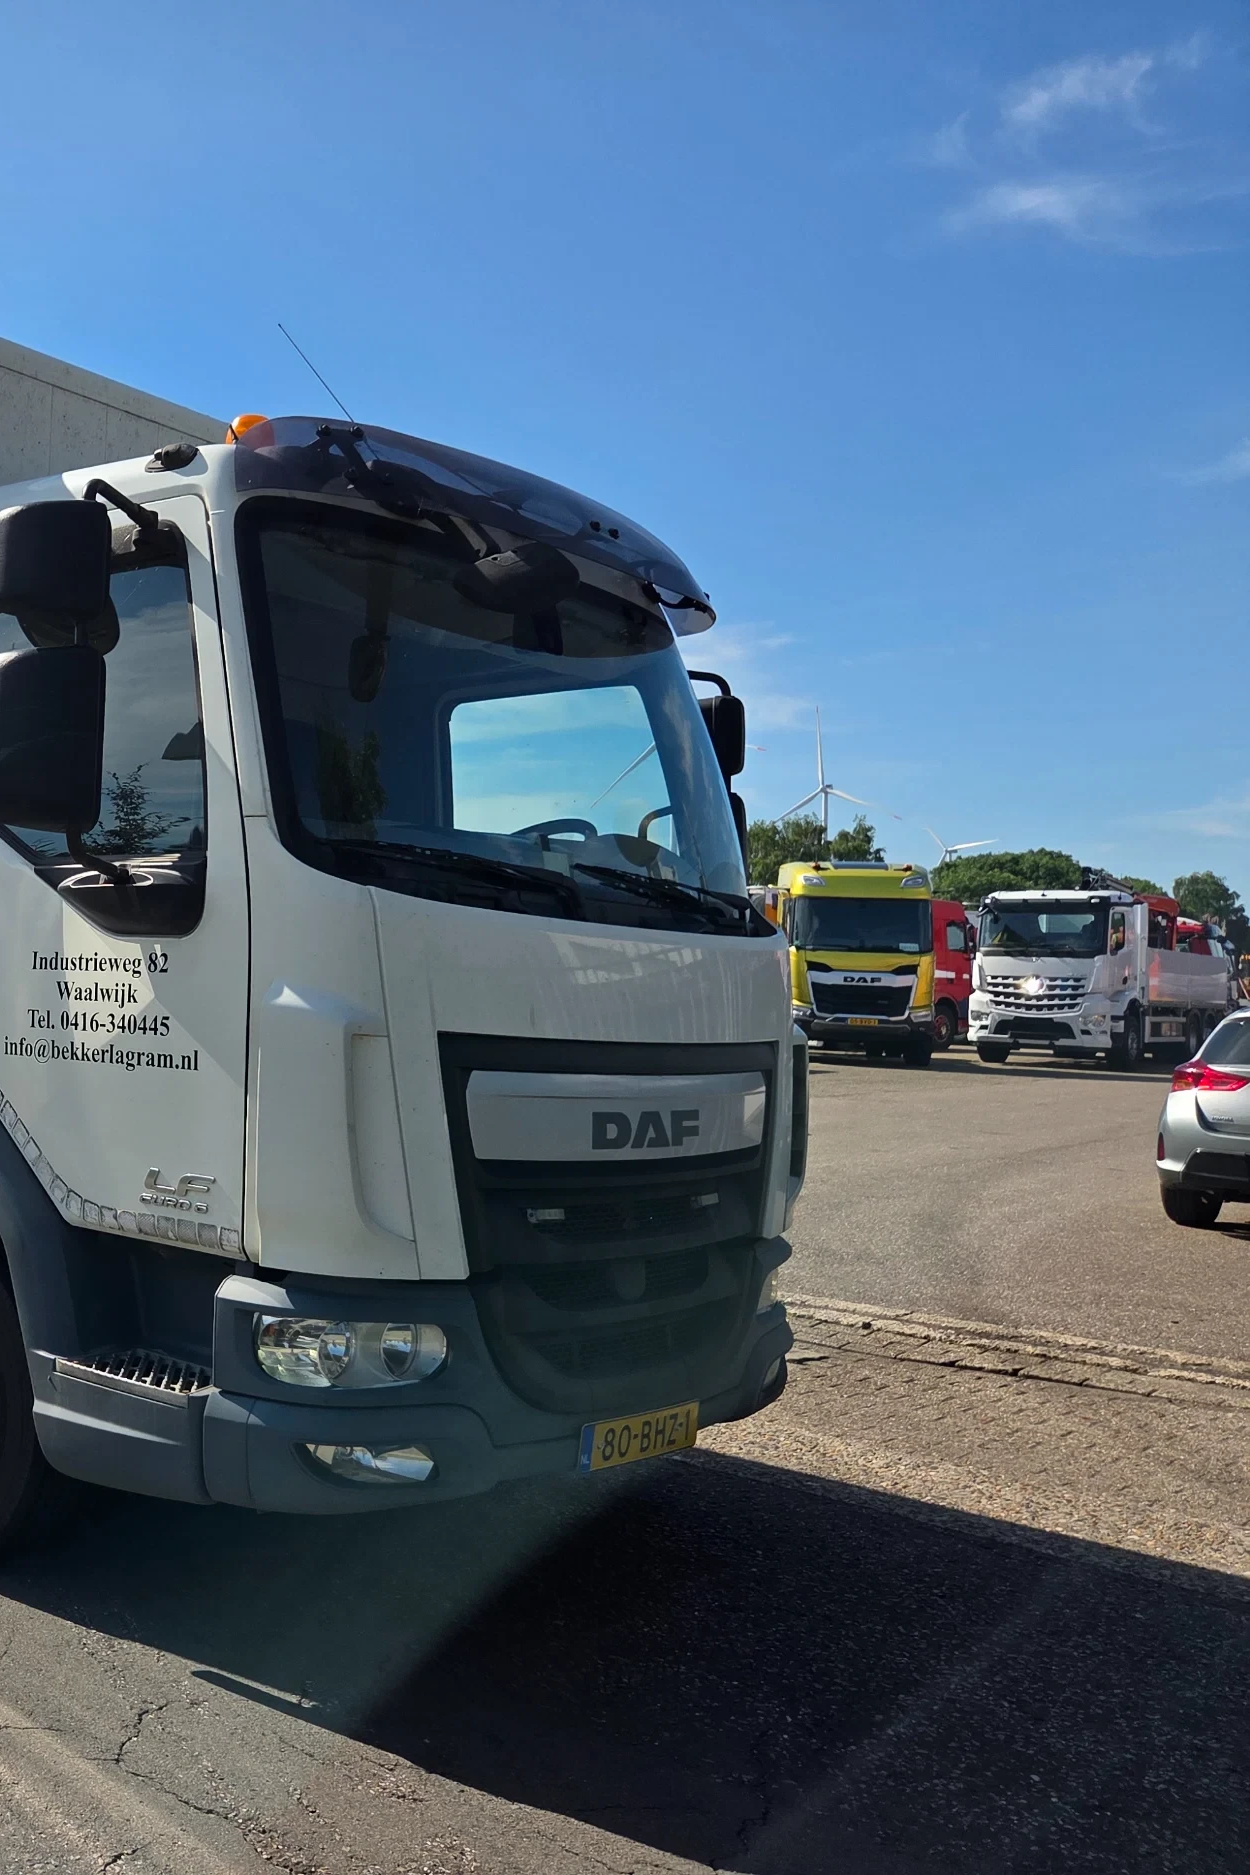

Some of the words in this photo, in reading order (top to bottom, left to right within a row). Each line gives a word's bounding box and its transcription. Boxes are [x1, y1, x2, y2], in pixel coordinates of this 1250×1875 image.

[32, 951, 142, 978] Industrieweg
[147, 952, 169, 973] 82
[56, 981, 138, 1008] Waalwijk
[28, 1009, 55, 1030] Tel.
[60, 1010, 170, 1036] 0416-340445
[4, 1036, 199, 1071] info@bekkerlagram.nl
[592, 1109, 700, 1149] DAF
[144, 1167, 216, 1197] LF
[140, 1193, 191, 1211] EURO
[194, 1202, 209, 1214] 6
[602, 1409, 691, 1461] 80-BHZ-1
